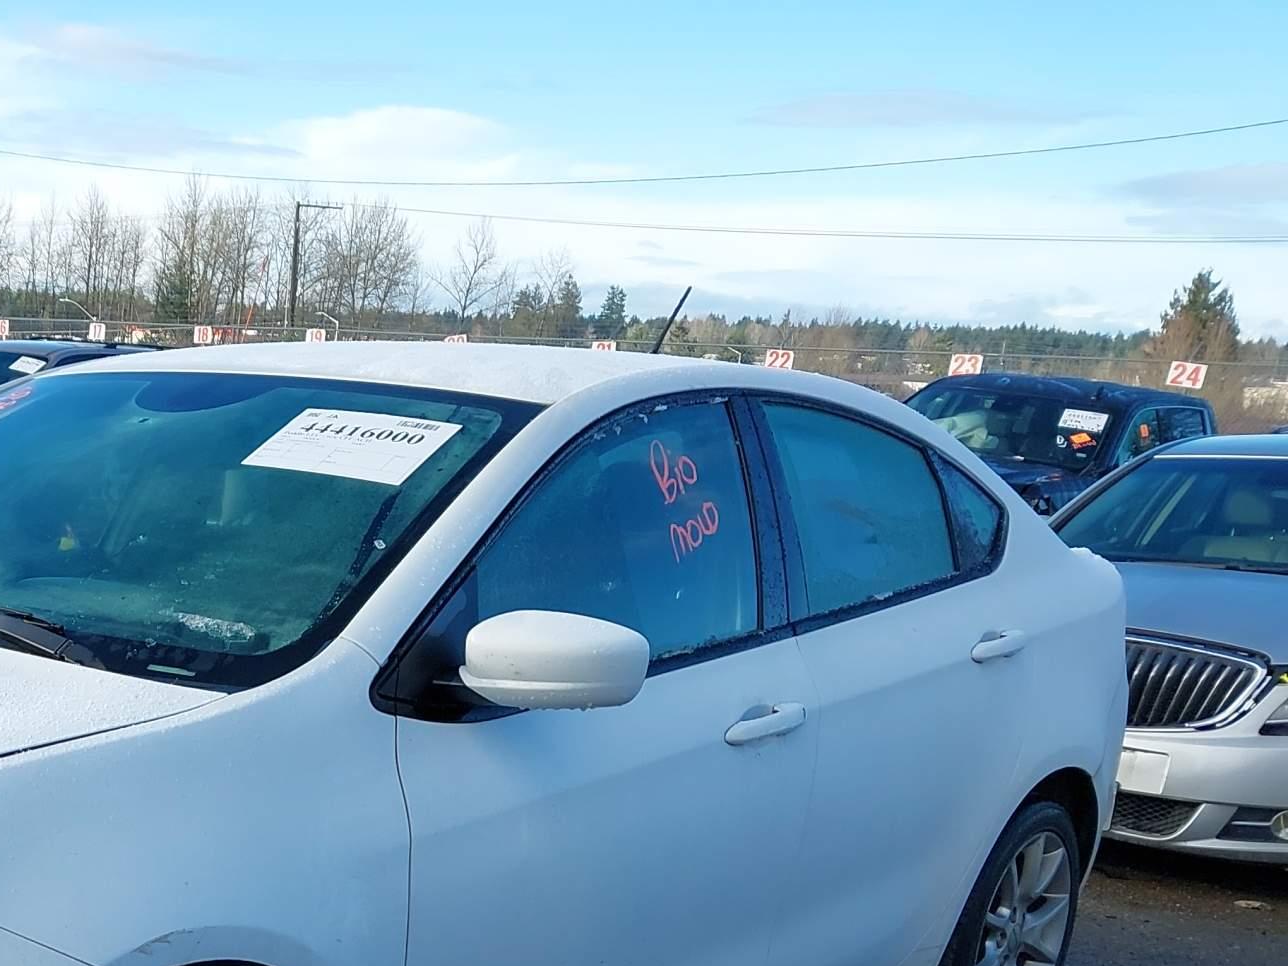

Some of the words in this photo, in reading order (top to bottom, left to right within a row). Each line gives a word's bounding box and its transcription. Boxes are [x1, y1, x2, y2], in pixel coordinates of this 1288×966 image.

[92, 324, 104, 340] 17
[195, 326, 210, 343] 18
[767, 350, 791, 369] 22
[951, 355, 980, 376] 23
[1169, 362, 1202, 387] 24
[300, 422, 426, 446] 44416000
